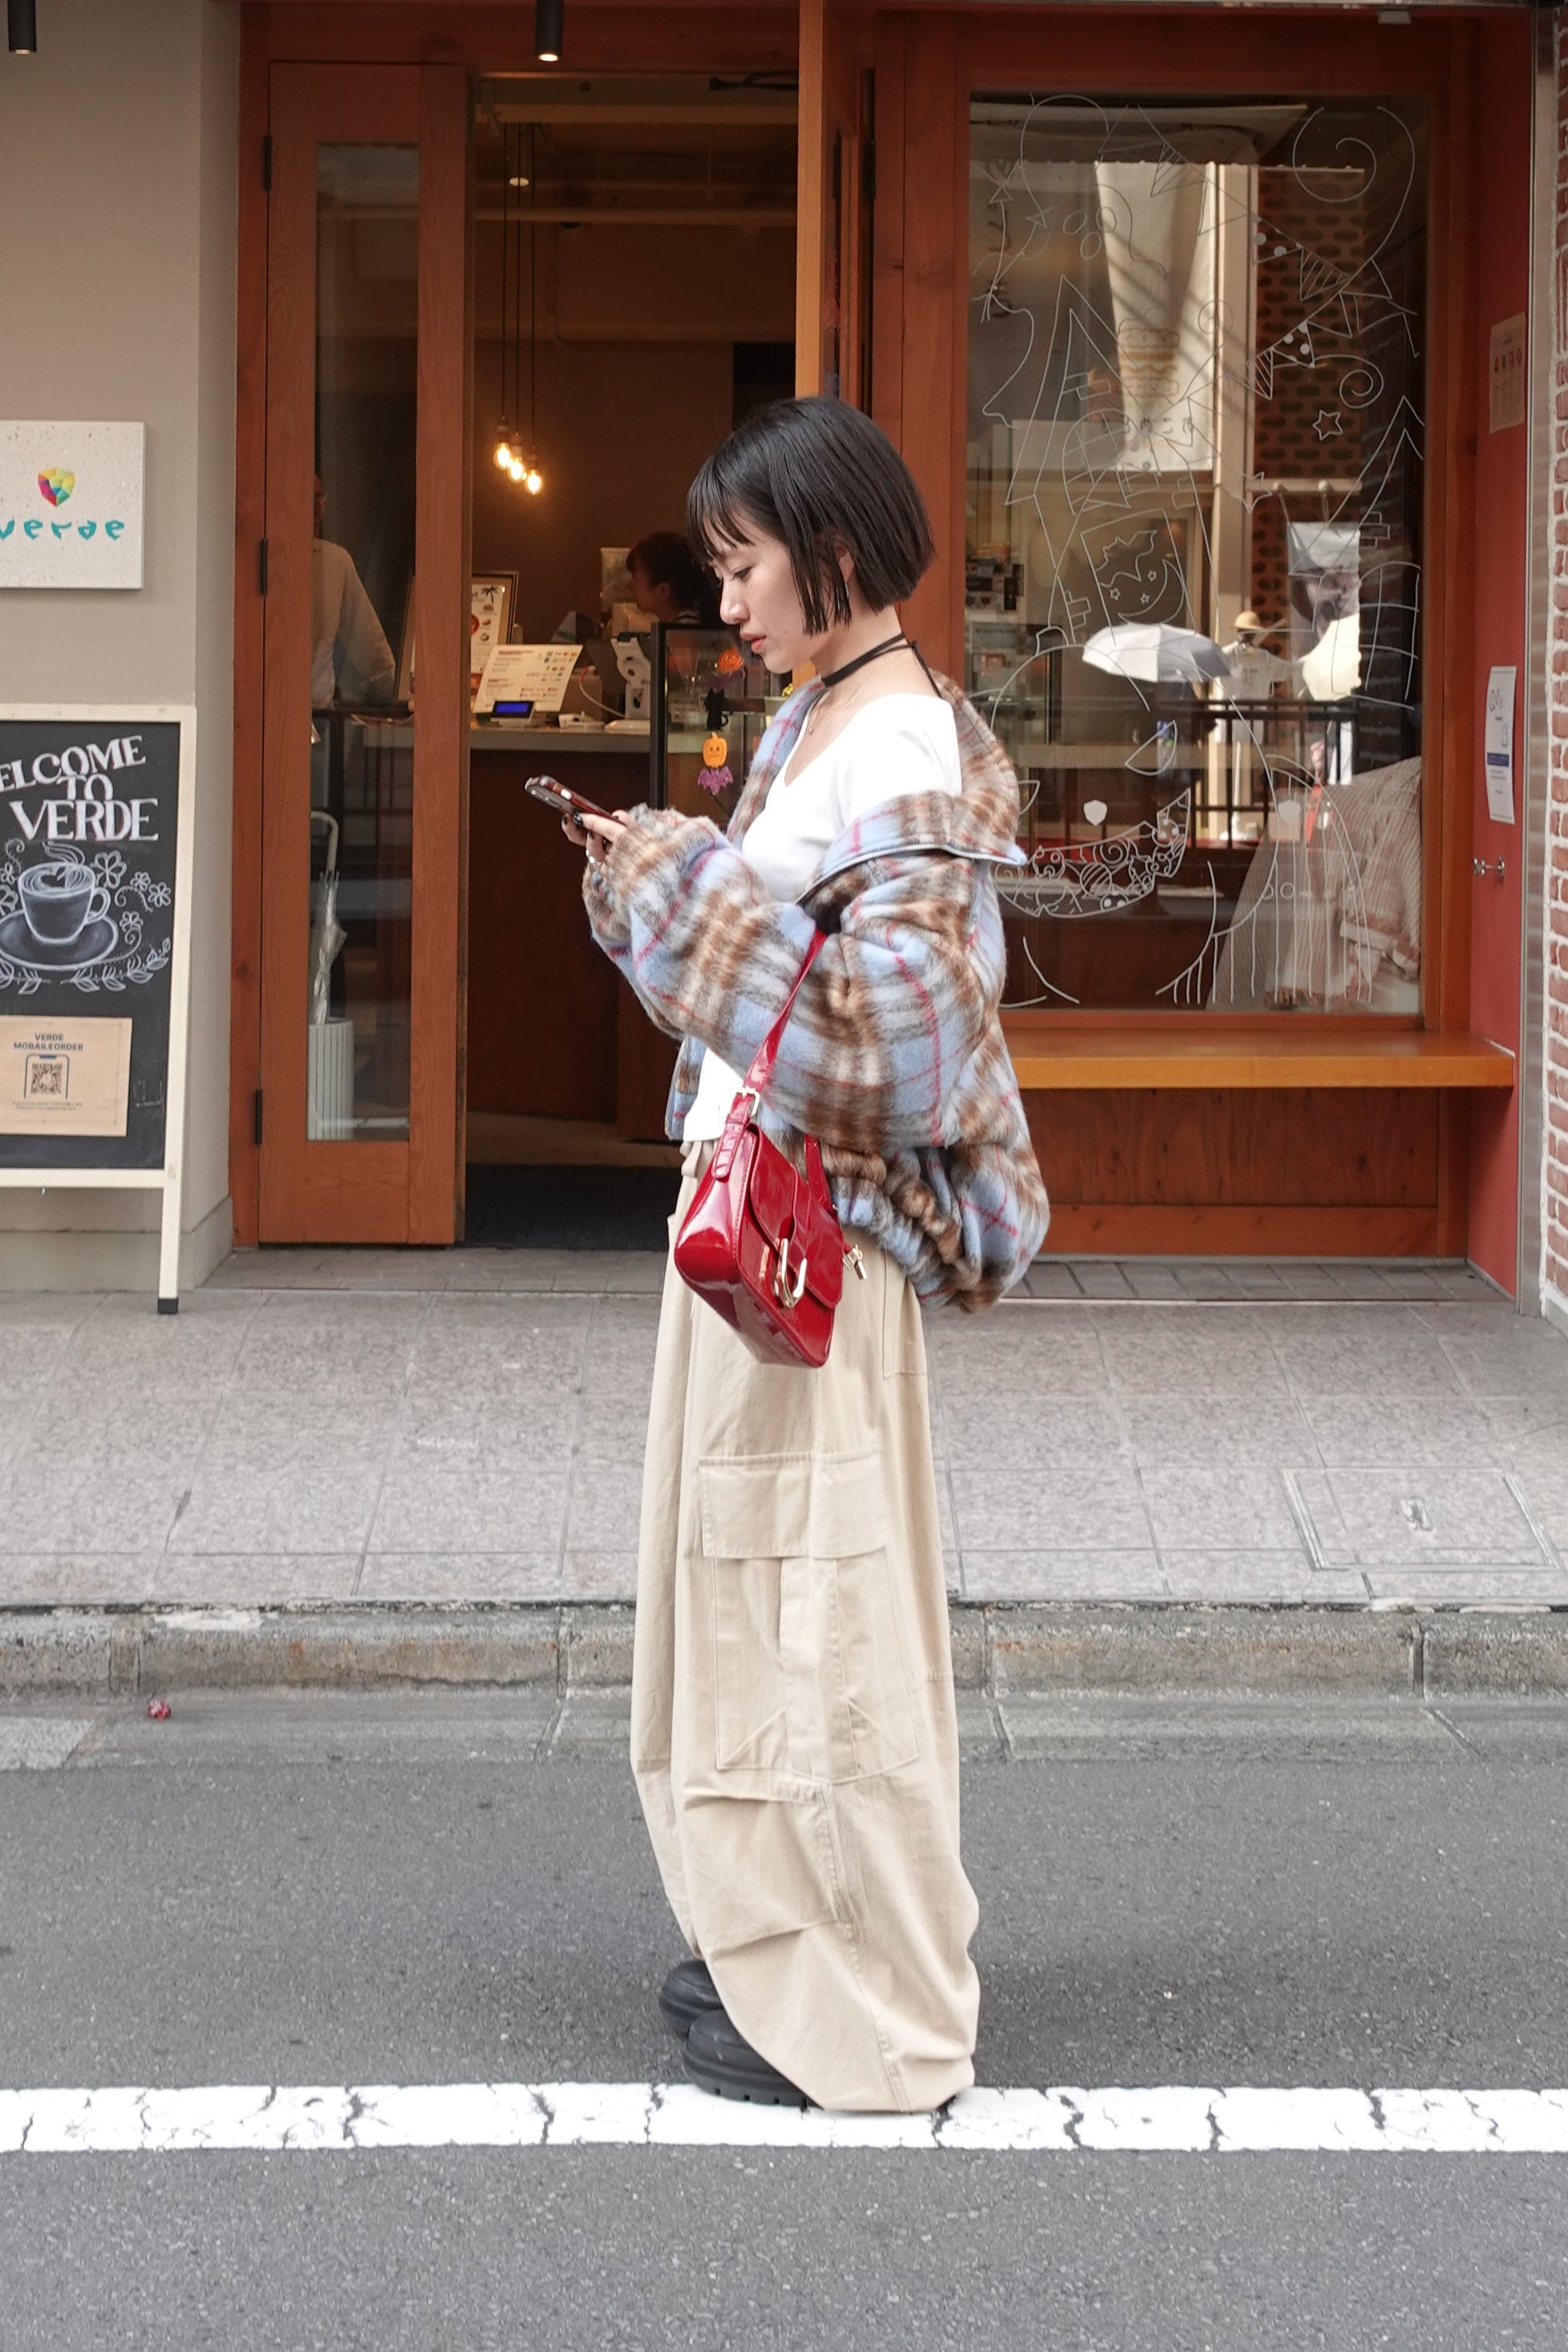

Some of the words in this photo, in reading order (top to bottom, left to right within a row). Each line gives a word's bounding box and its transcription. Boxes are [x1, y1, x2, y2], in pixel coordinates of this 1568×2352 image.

[56, 773, 114, 801] TO
[9, 798, 160, 841] VERDE
[34, 1032, 64, 1041] VERDE
